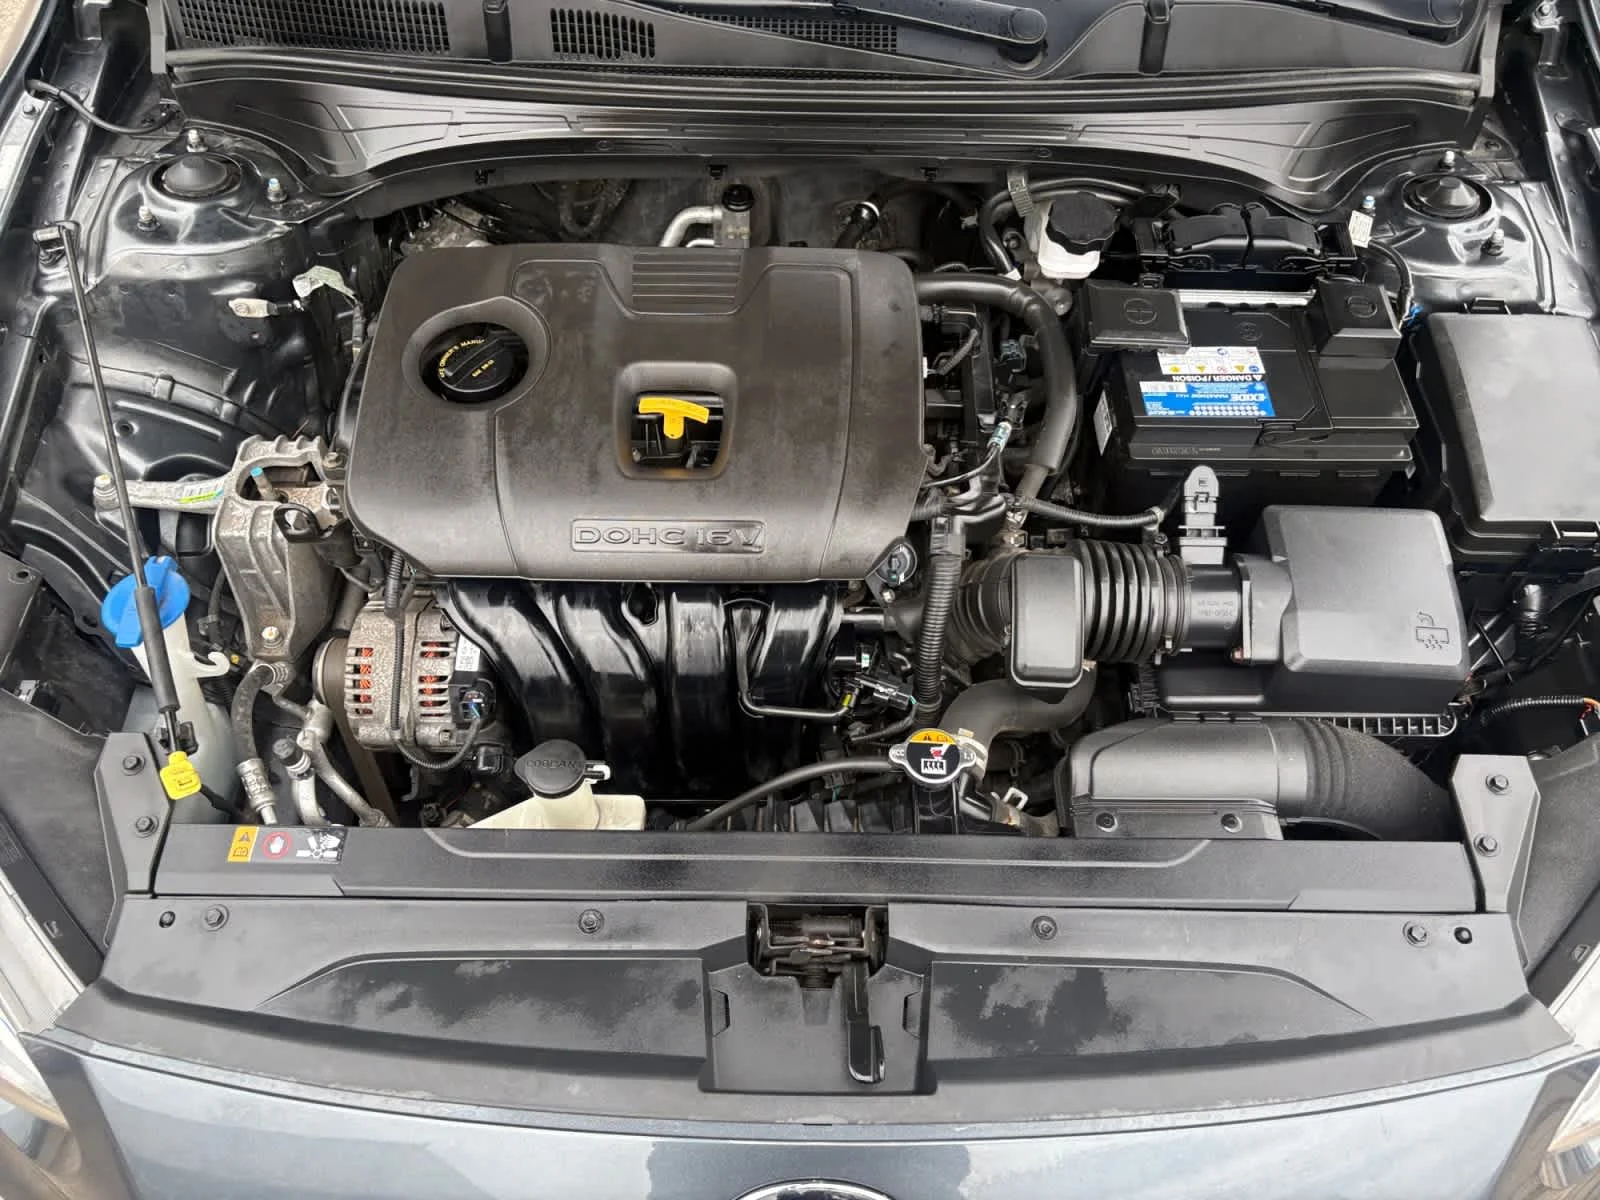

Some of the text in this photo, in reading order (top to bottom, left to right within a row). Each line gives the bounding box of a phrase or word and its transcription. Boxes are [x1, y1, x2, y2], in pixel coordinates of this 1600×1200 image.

[1230, 393, 1266, 401] EXIDE
[574, 527, 762, 546] DOHC 16V
